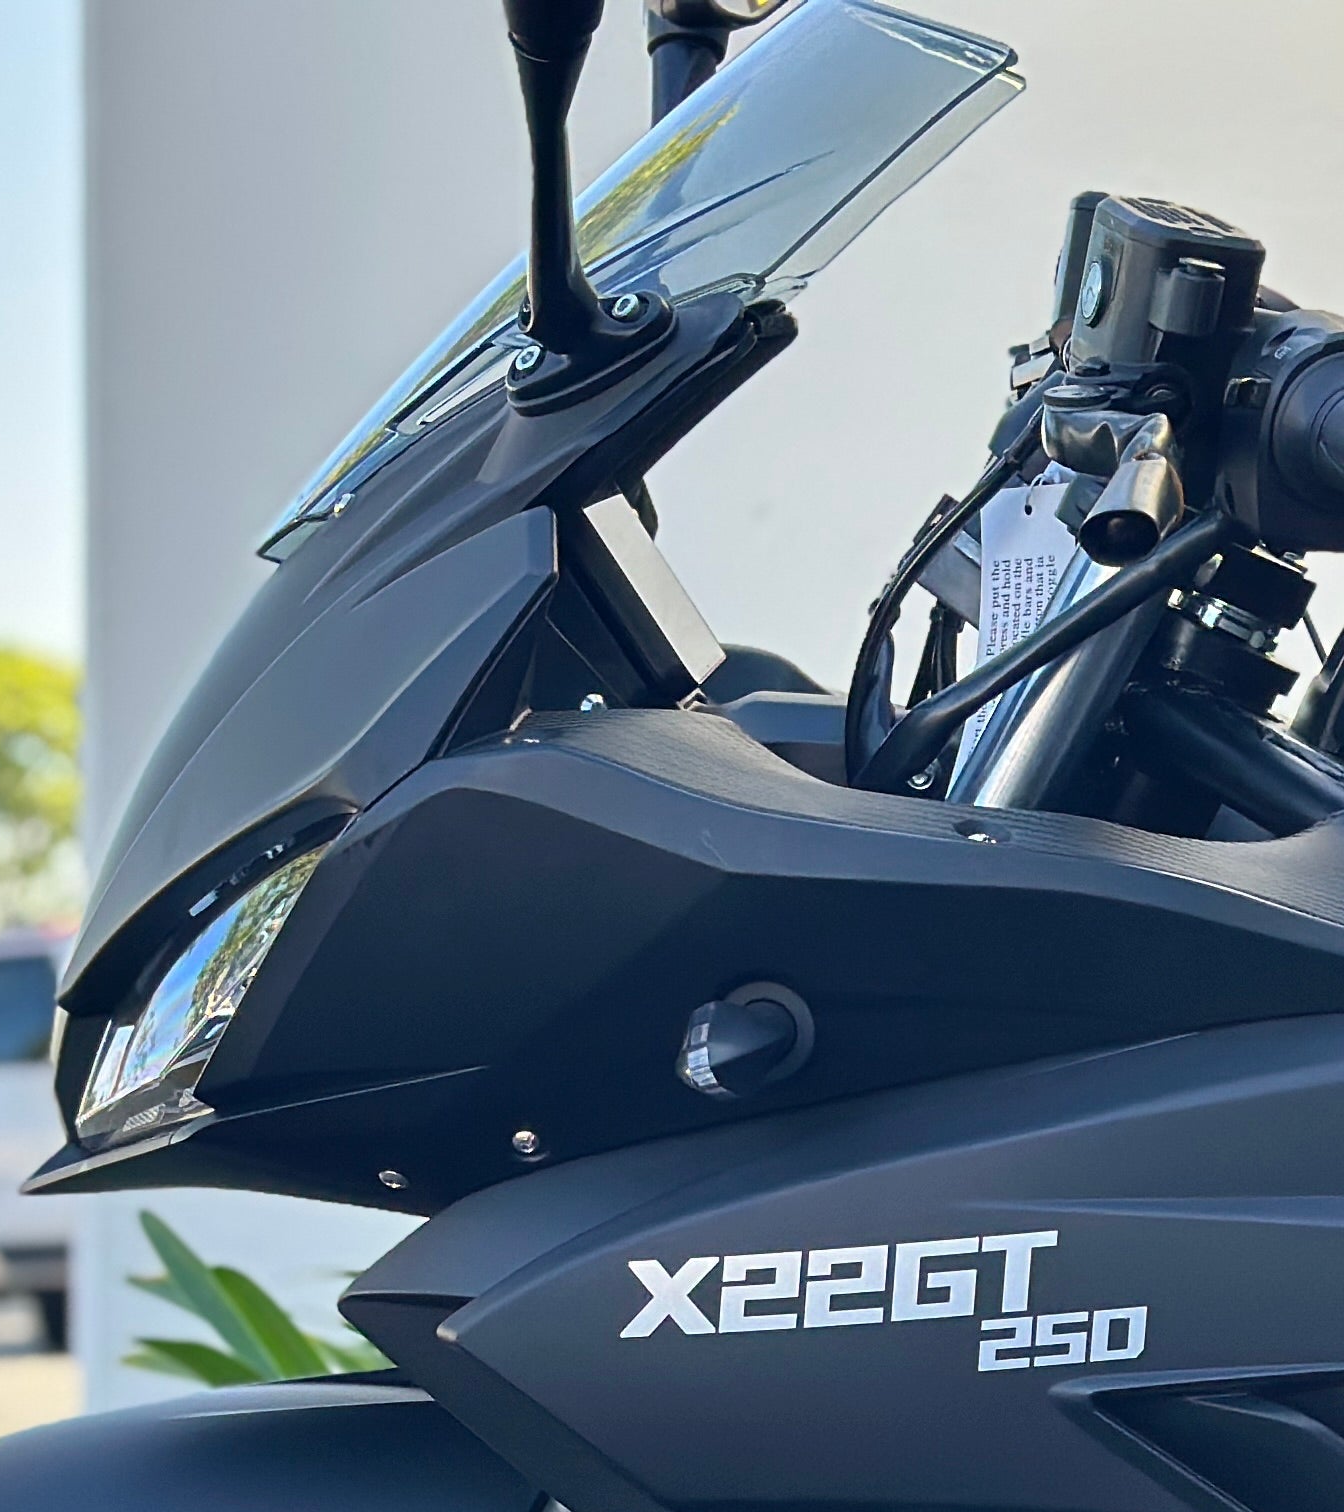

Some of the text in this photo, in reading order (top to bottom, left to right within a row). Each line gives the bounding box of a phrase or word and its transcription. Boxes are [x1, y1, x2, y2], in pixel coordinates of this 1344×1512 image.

[1001, 559, 1011, 589] hold
[1024, 558, 1033, 583] and
[1035, 572, 1044, 597] that
[986, 560, 1001, 656] Please put the
[1001, 594, 1010, 618] and
[1012, 558, 1022, 645] ocated on the
[1022, 587, 1032, 617] bars
[620, 1230, 1058, 1339] X22GT
[978, 1305, 1148, 1372] 250
